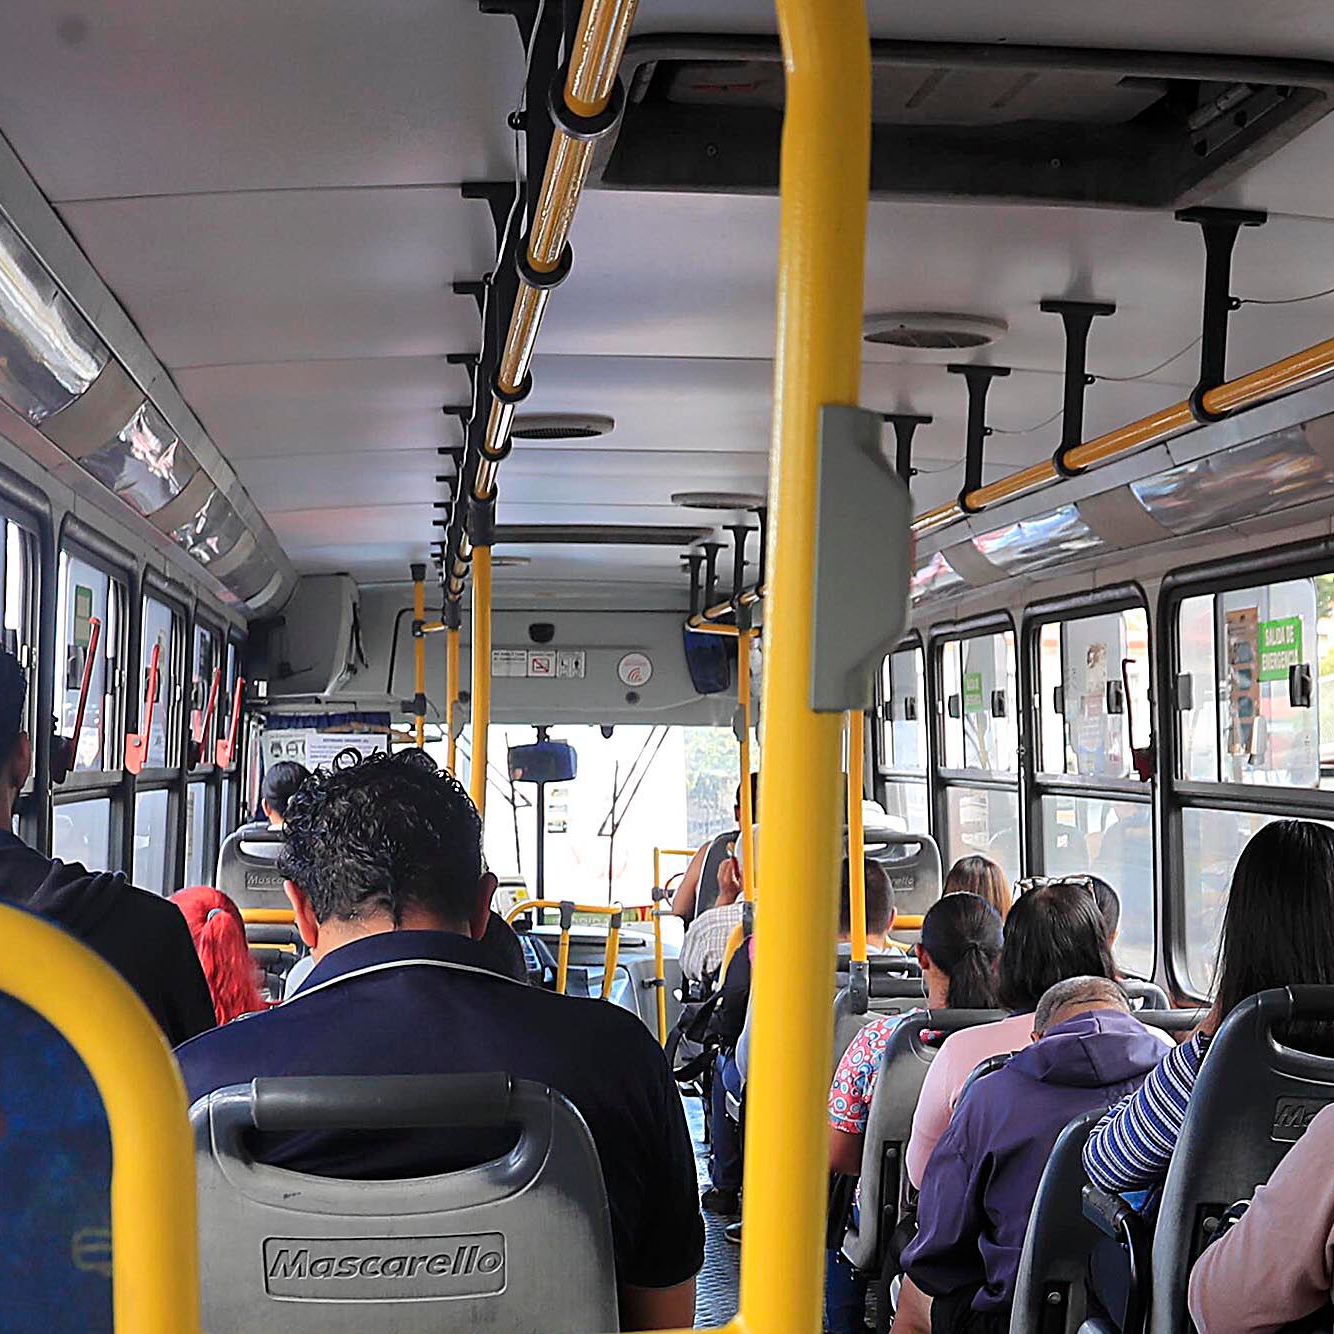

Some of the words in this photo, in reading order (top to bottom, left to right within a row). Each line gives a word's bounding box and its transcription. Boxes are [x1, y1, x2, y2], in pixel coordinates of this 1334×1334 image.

[1265, 626, 1285, 646] SALIDA
[1285, 624, 1295, 643] DE
[268, 1245, 504, 1280] Mascarello
